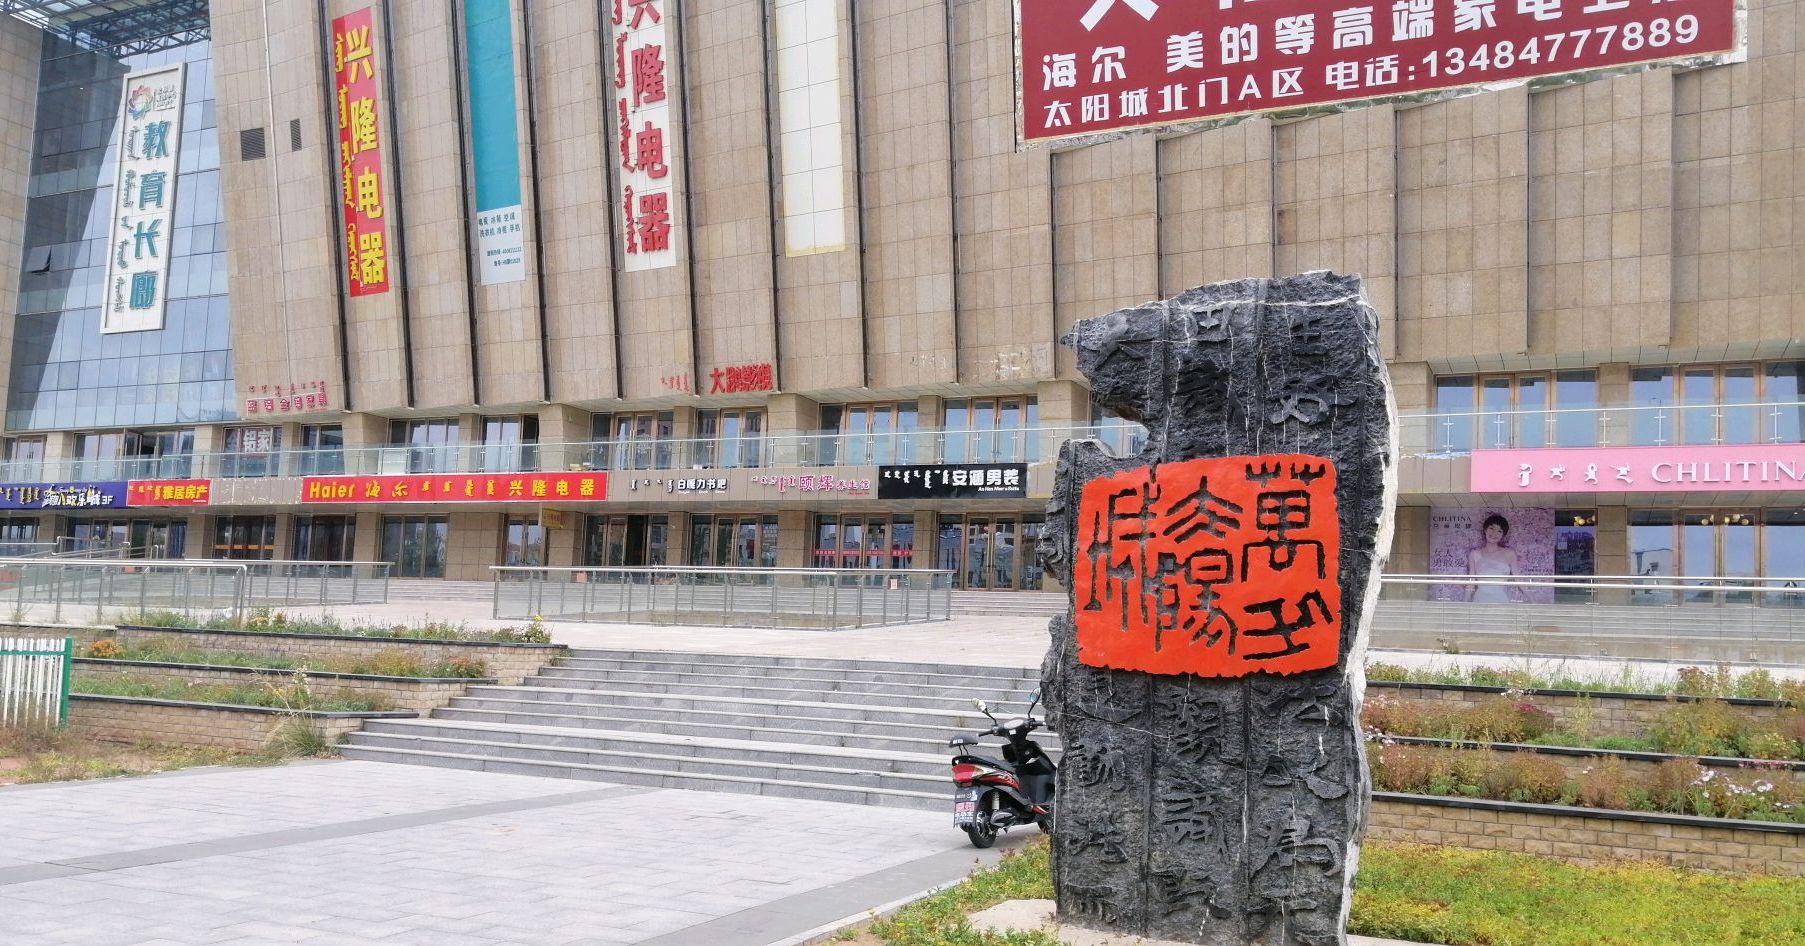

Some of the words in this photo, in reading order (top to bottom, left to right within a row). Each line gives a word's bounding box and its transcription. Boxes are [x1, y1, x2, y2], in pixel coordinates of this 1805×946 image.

[1043, 45, 1127, 91] 海尔
[1044, 67, 1304, 128] 太阳城北门A区
[1325, 14, 1699, 91] 电话:13484777889
[344, 25, 386, 287] 兴隆电器
[309, 481, 355, 499] Haier
[365, 481, 409, 498] 海尔
[508, 478, 596, 497] 兴隆电器
